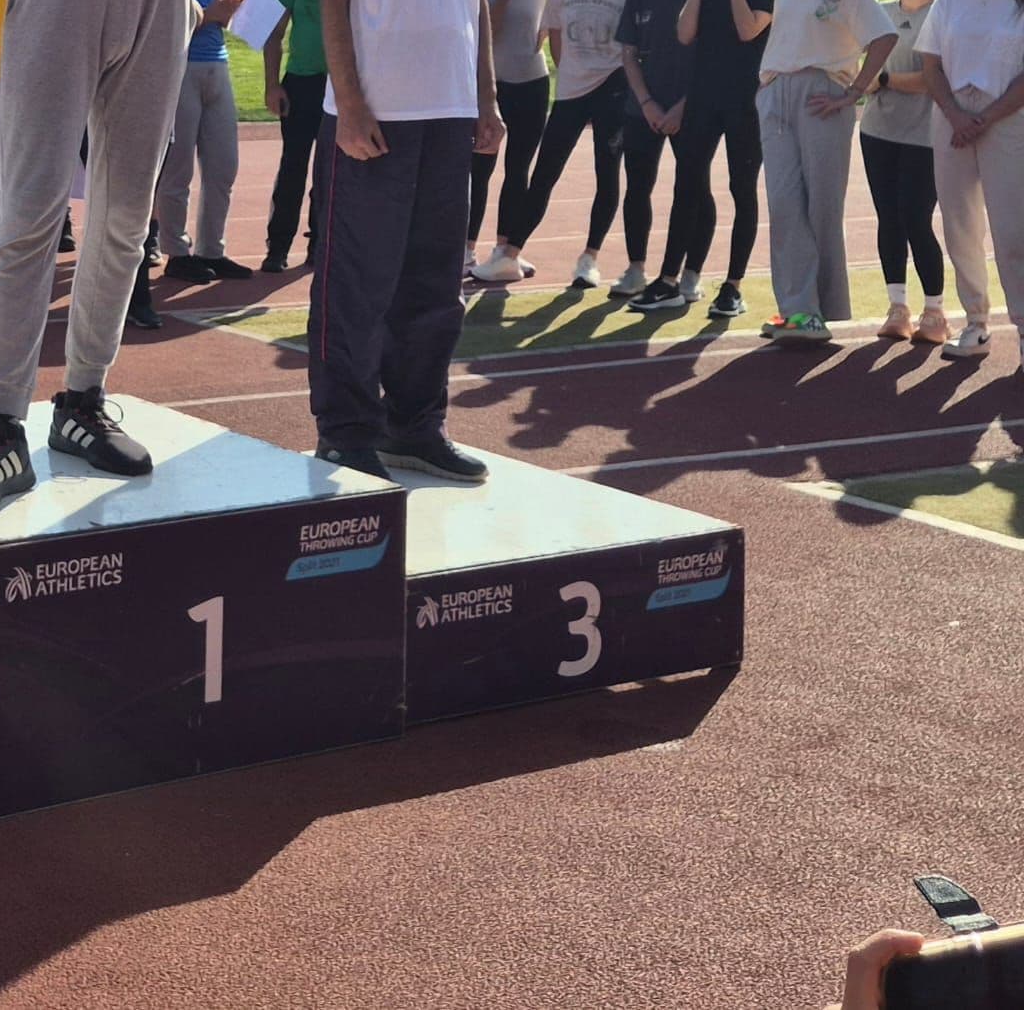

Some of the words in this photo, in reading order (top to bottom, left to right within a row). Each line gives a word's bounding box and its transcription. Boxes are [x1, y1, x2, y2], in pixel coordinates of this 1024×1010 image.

[300, 515, 381, 541] EUROPEAN
[299, 535, 355, 553] THROWING
[357, 531, 378, 543] CUP
[36, 552, 123, 580] EUROPEAN
[658, 549, 724, 574] EUROPEAN
[35, 569, 123, 597] ATHLETICS
[658, 568, 703, 585] THROWING
[705, 565, 723, 577] CUP
[441, 584, 513, 608] EUROPEAN
[441, 599, 513, 624] ATHLETICS
[556, 580, 602, 678] 3
[187, 596, 224, 703] 1
